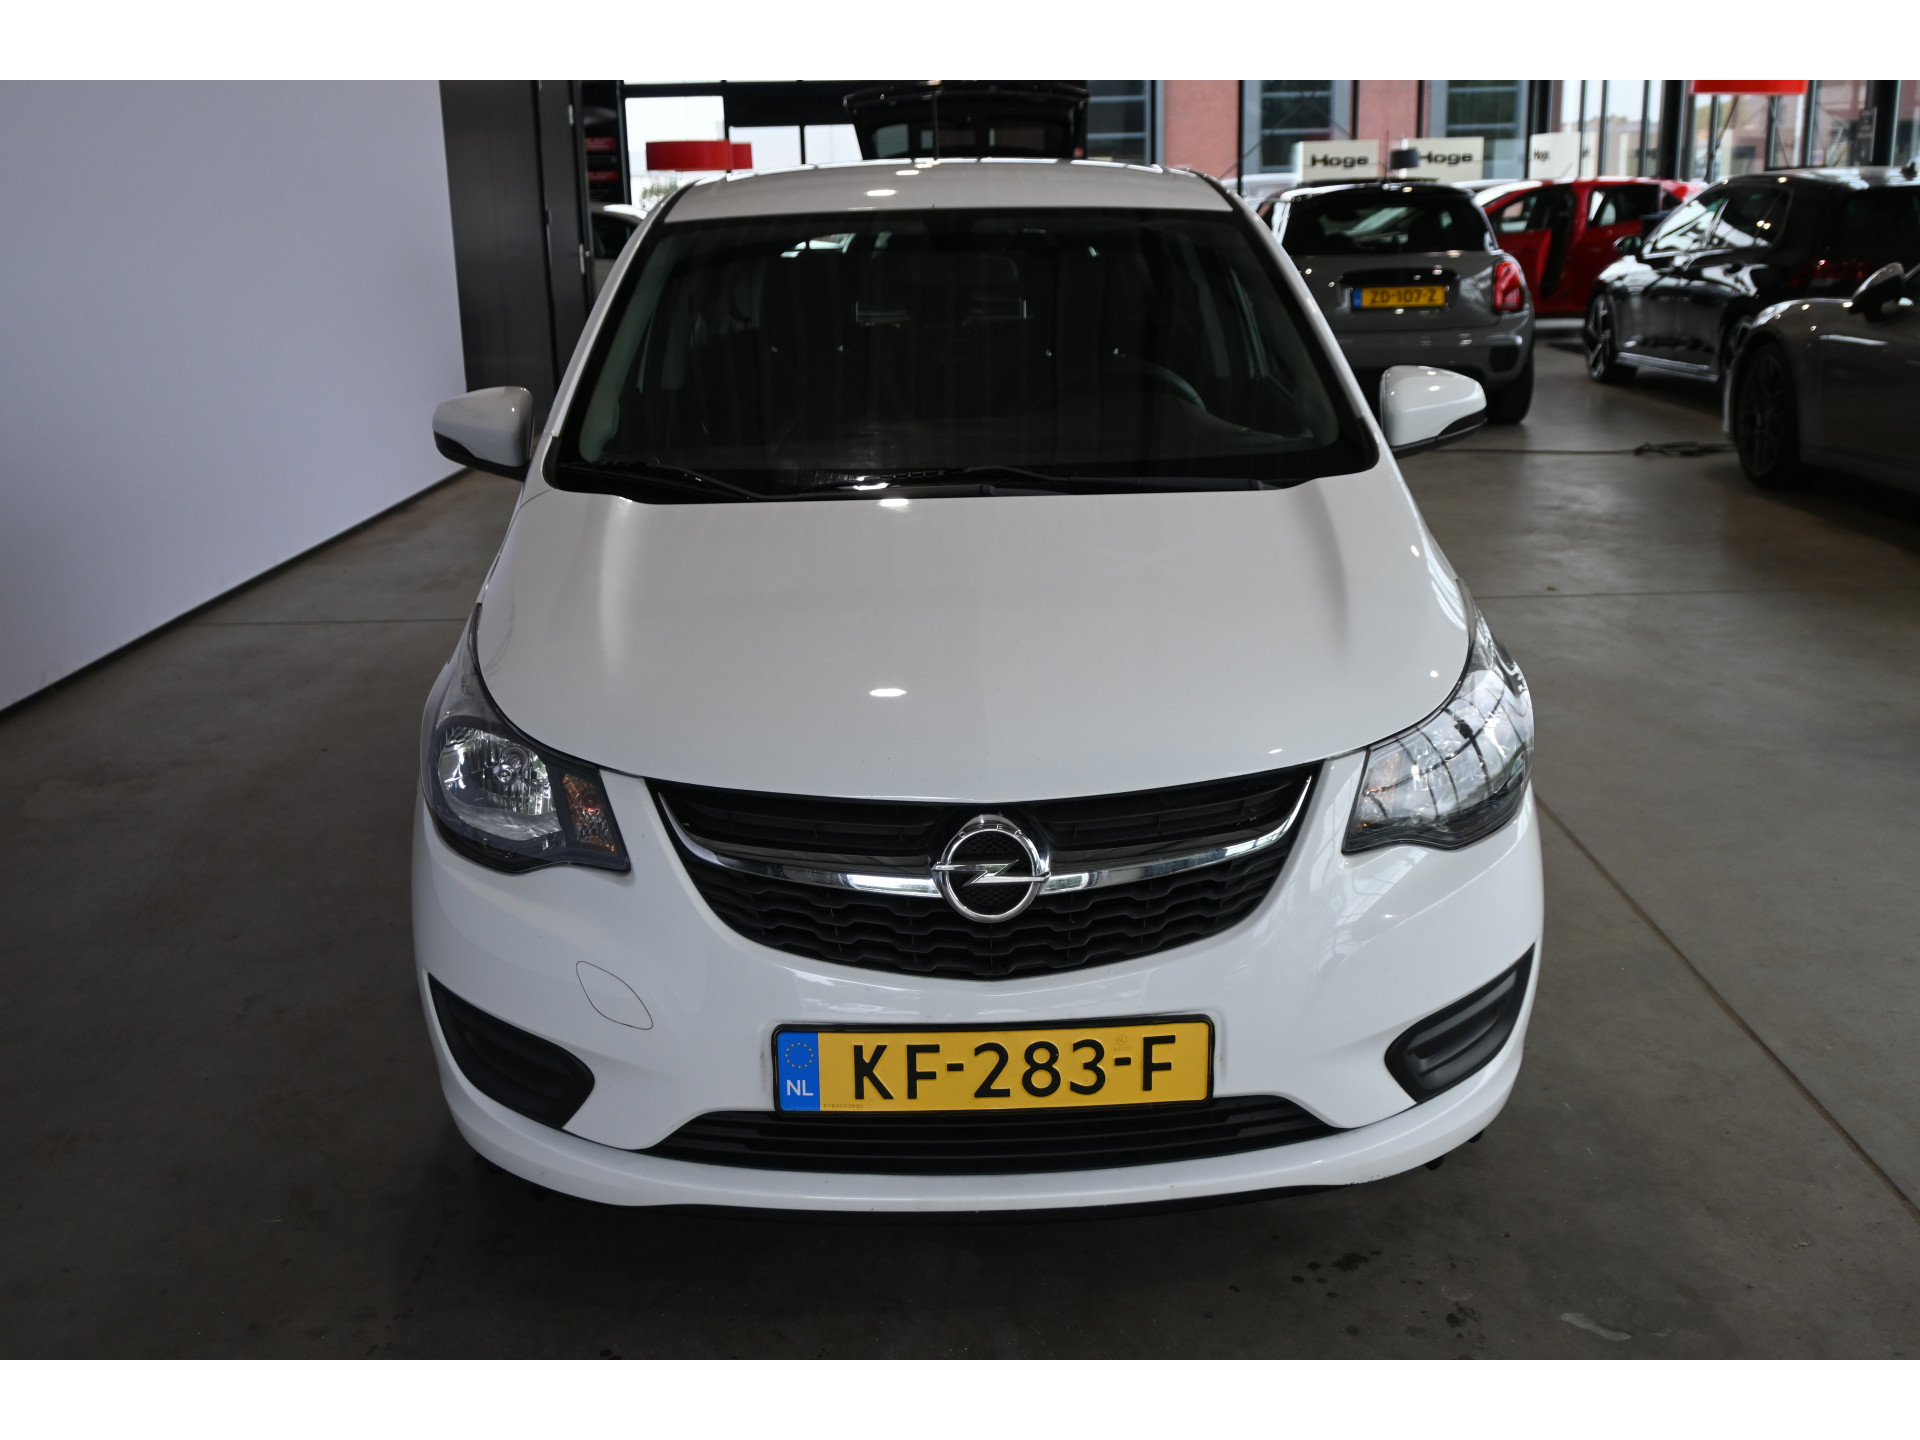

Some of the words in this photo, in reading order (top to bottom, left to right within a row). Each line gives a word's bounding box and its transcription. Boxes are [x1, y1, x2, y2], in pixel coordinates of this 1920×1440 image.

[1311, 154, 1369, 168] Hoge
[1371, 285, 1437, 304] ZD-107-Z
[852, 1034, 1177, 1101] KF-283-F
[785, 1079, 814, 1097] NL
